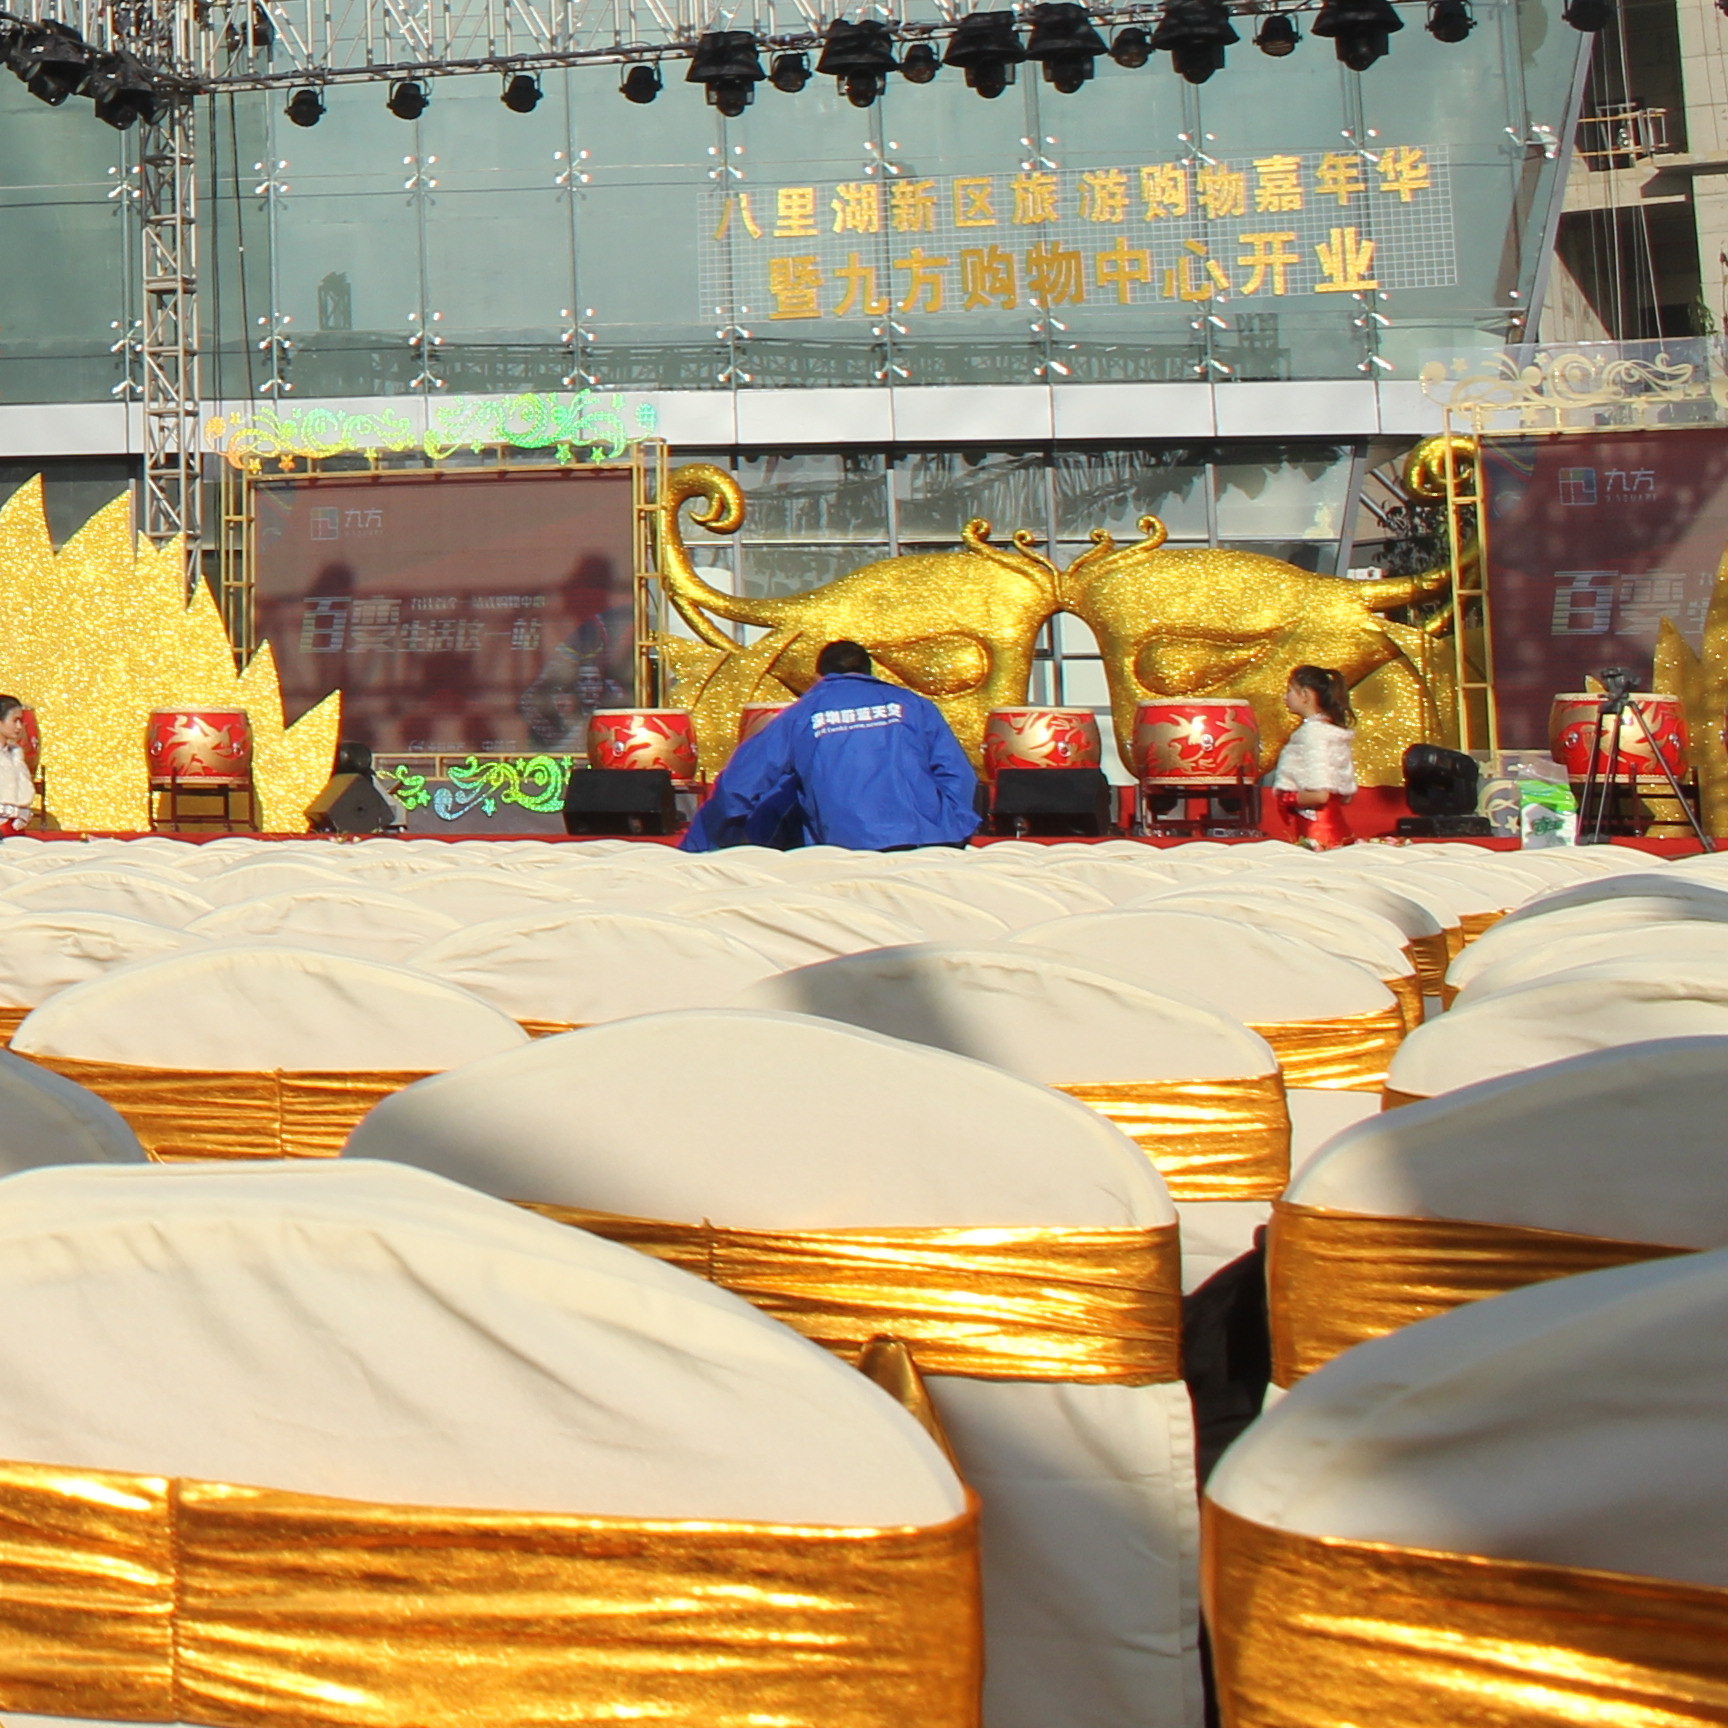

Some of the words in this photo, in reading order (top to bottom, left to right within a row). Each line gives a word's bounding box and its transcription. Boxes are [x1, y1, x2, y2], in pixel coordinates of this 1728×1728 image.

[713, 145, 1432, 240] 八里湖新区旅游购物嘉年华
[767, 226, 1381, 321] 暨九方购物中心开业
[1604, 468, 1655, 492] 九方
[344, 507, 383, 529] 九方
